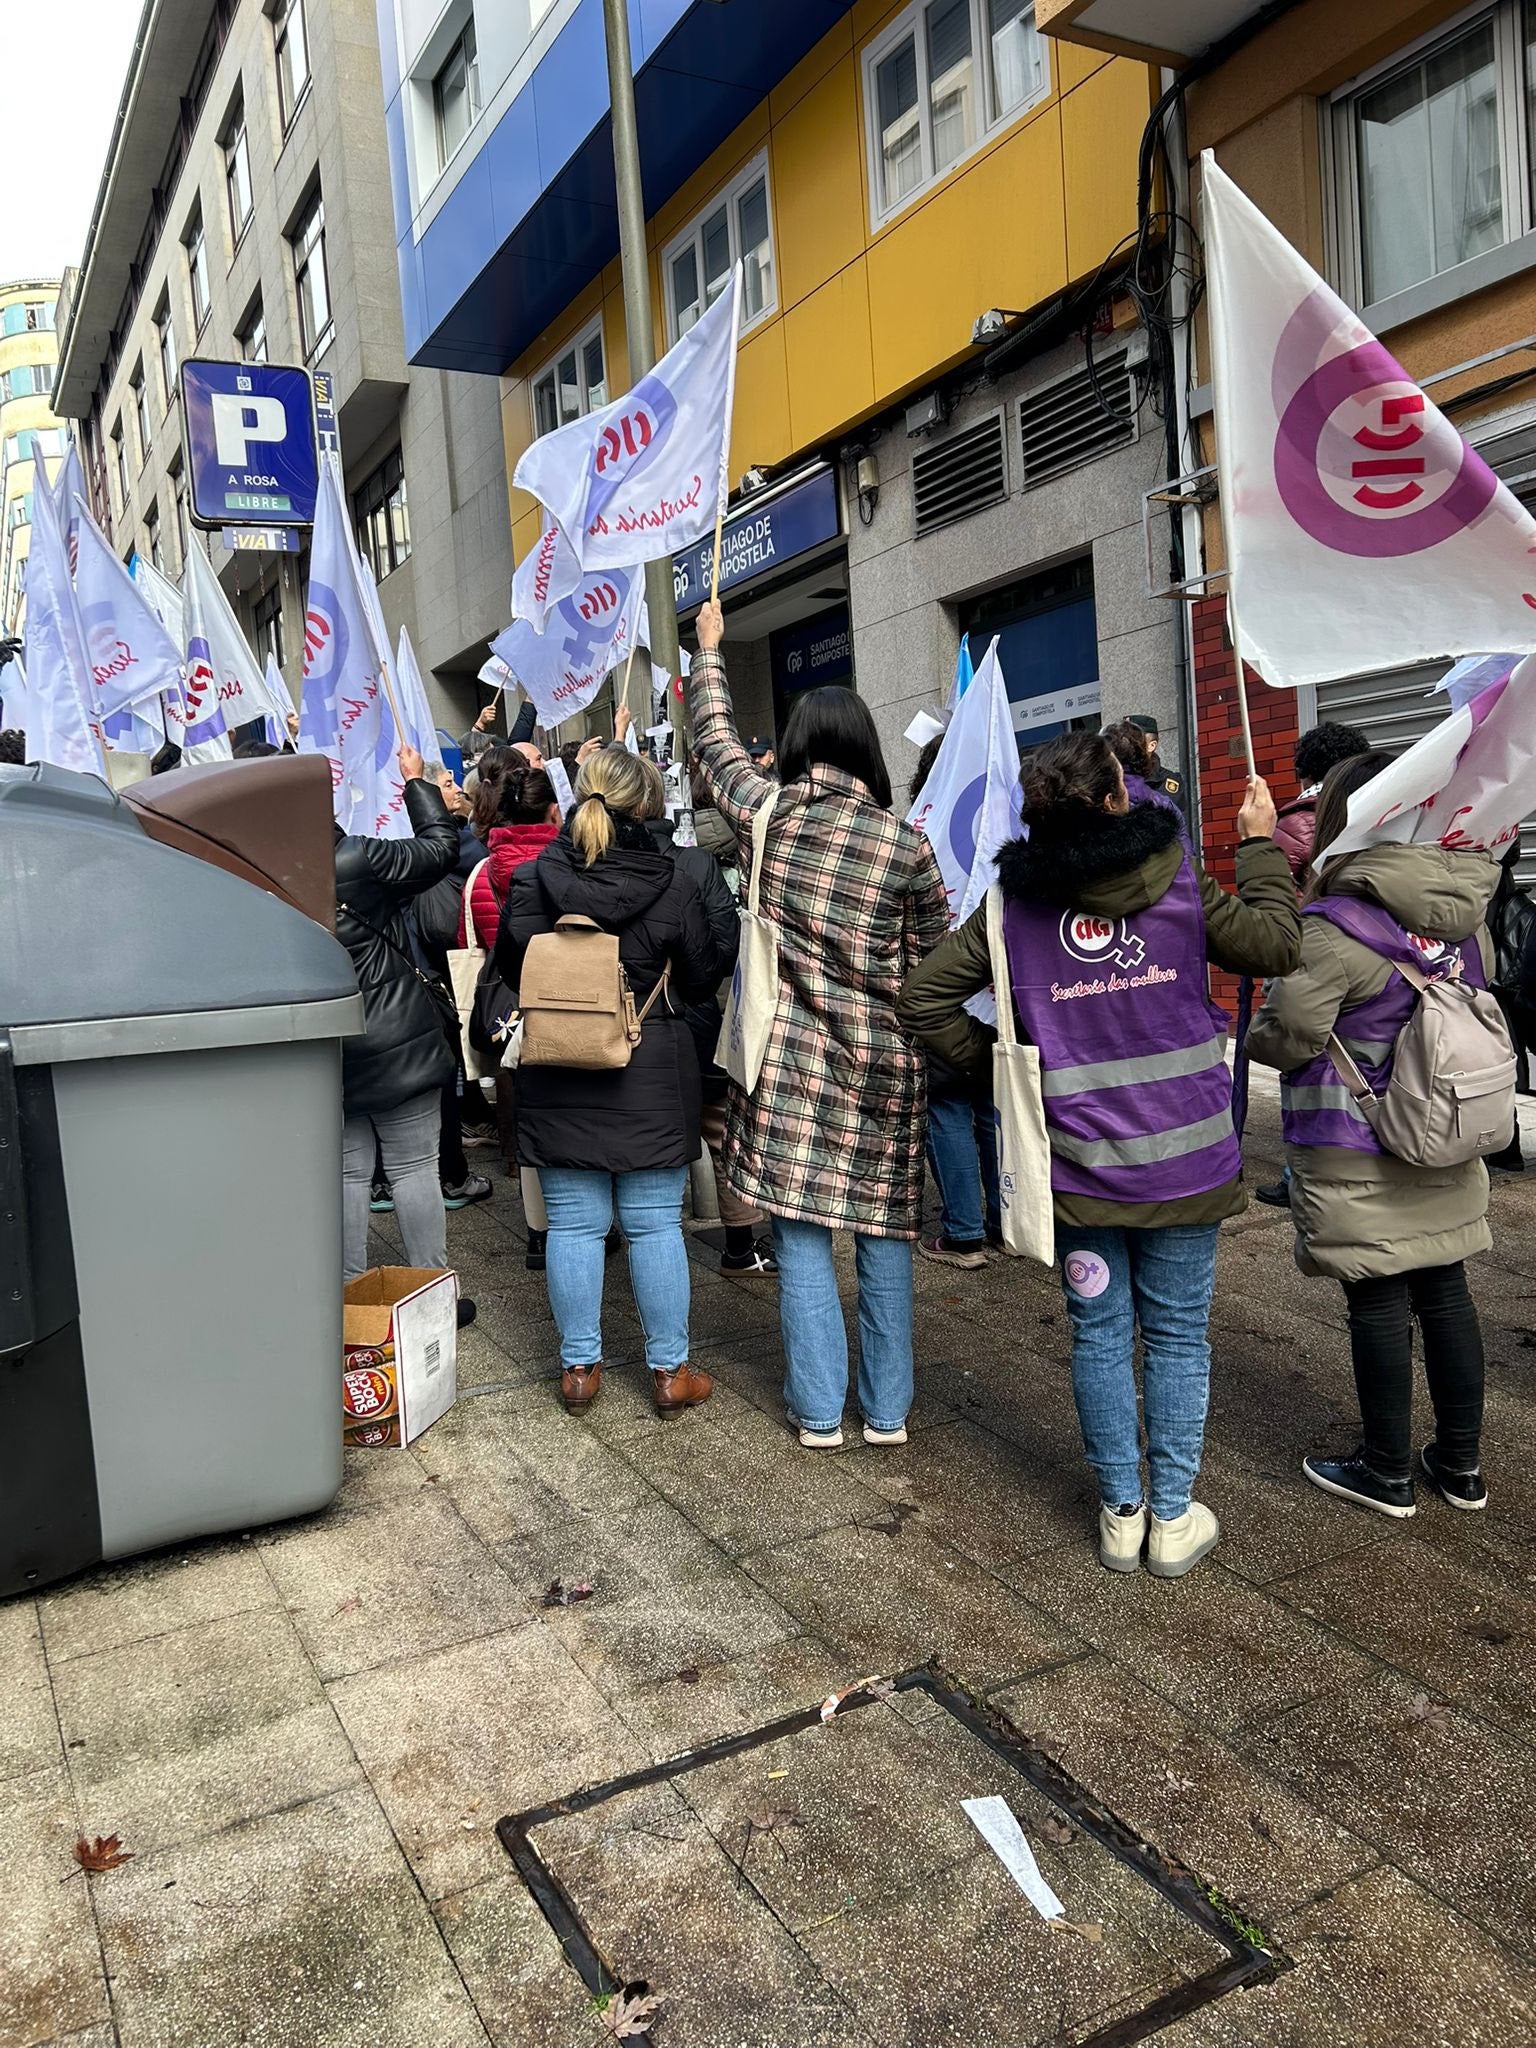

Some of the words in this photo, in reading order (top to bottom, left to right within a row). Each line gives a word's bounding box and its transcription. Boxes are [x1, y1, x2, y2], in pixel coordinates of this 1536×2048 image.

[211, 393, 287, 466] P
[228, 474, 238, 485] A
[243, 474, 279, 487] ROSA
[238, 495, 279, 509] LIBRE
[755, 514, 772, 541] DE
[810, 632, 847, 656] SANTIAGO
[1075, 917, 1111, 940] CIG
[1107, 972, 1129, 992] das
[344, 1373, 368, 1414] SUPER
[356, 1371, 380, 1408] BOCK
